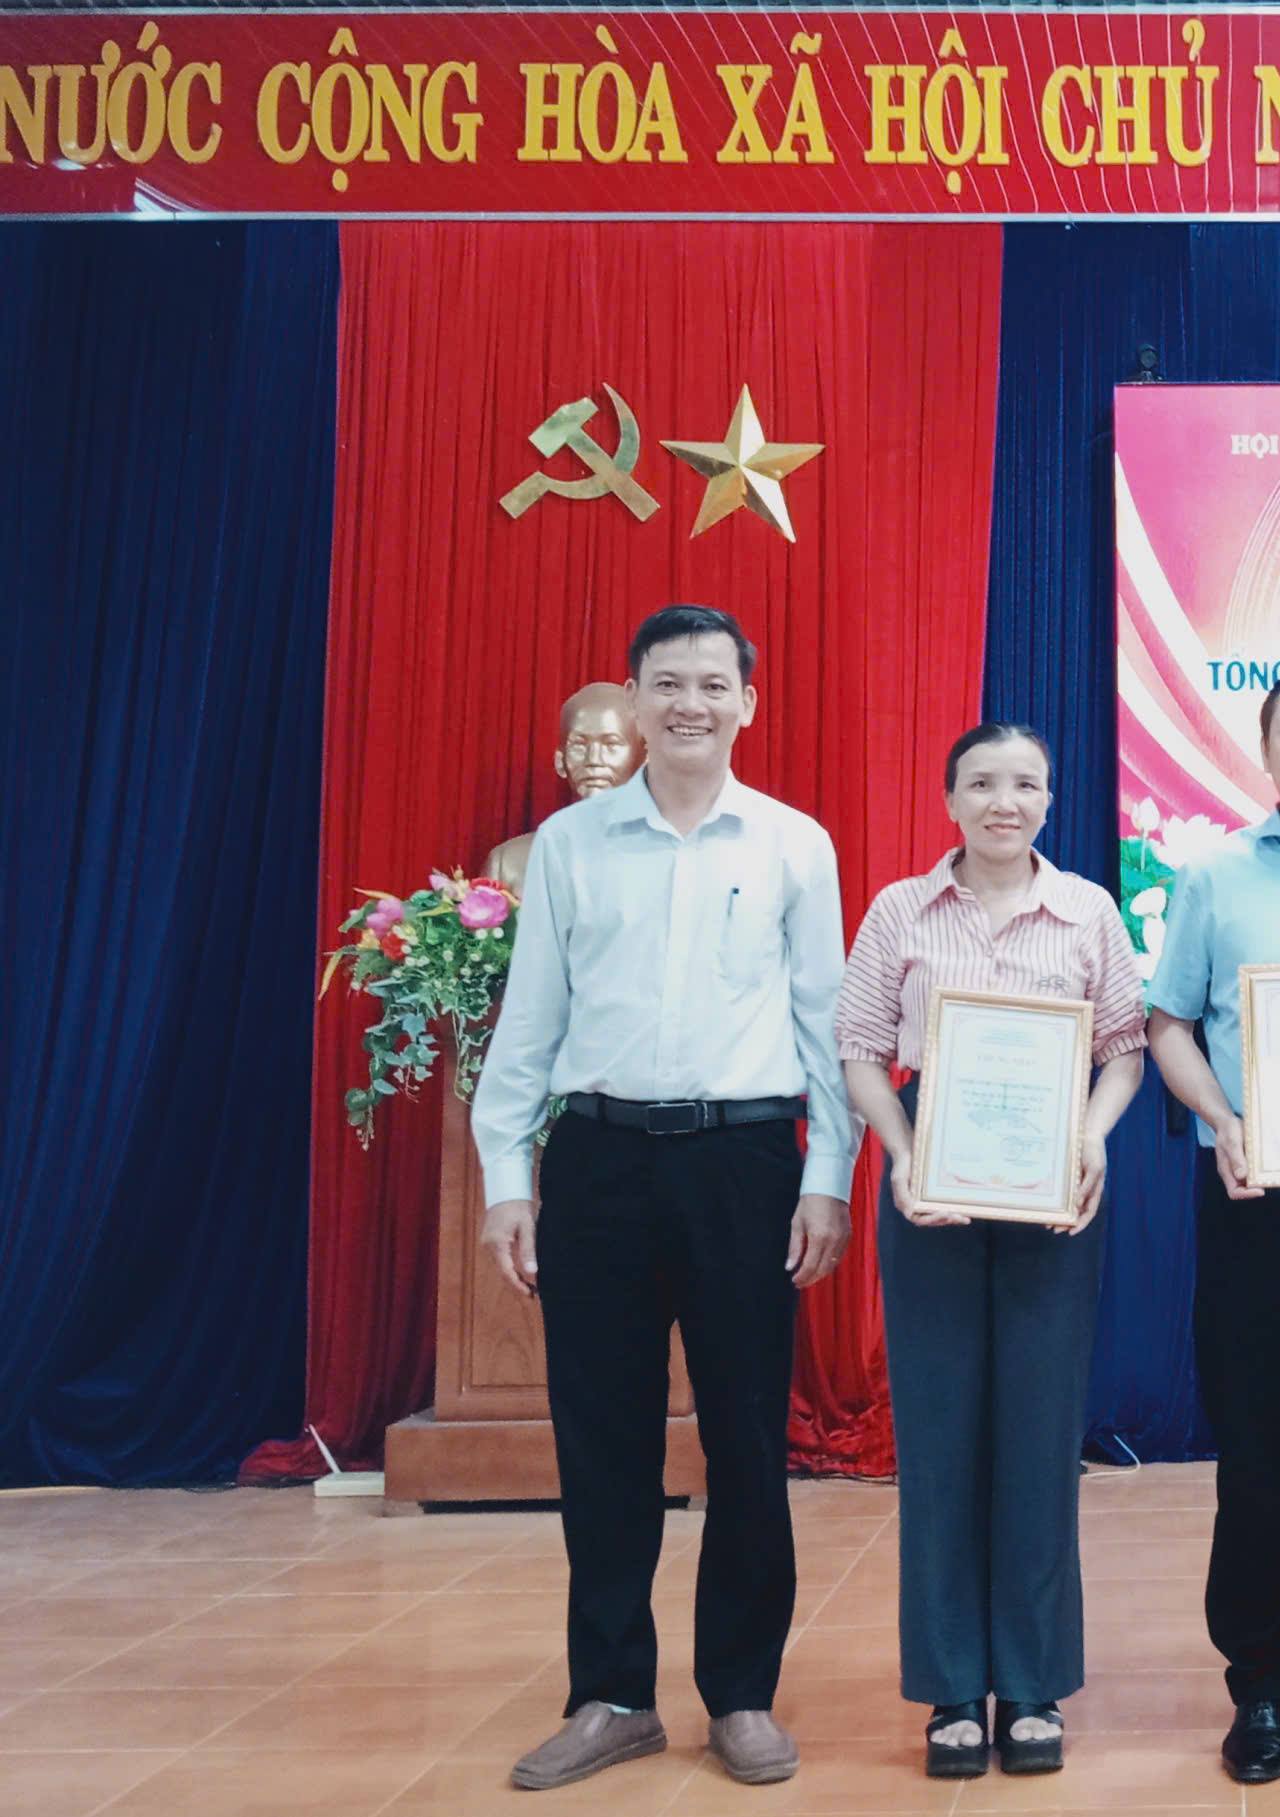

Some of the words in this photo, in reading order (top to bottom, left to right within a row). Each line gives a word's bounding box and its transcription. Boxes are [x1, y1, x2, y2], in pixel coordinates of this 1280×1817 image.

[0, 20, 222, 163] NƯỚC
[257, 28, 482, 192] CỘNG
[517, 26, 688, 163] HÒA
[716, 32, 834, 163] XÃ
[864, 28, 1009, 195] HỘI
[1042, 19, 1220, 166] CHỦ
[1231, 432, 1278, 458] HỘI
